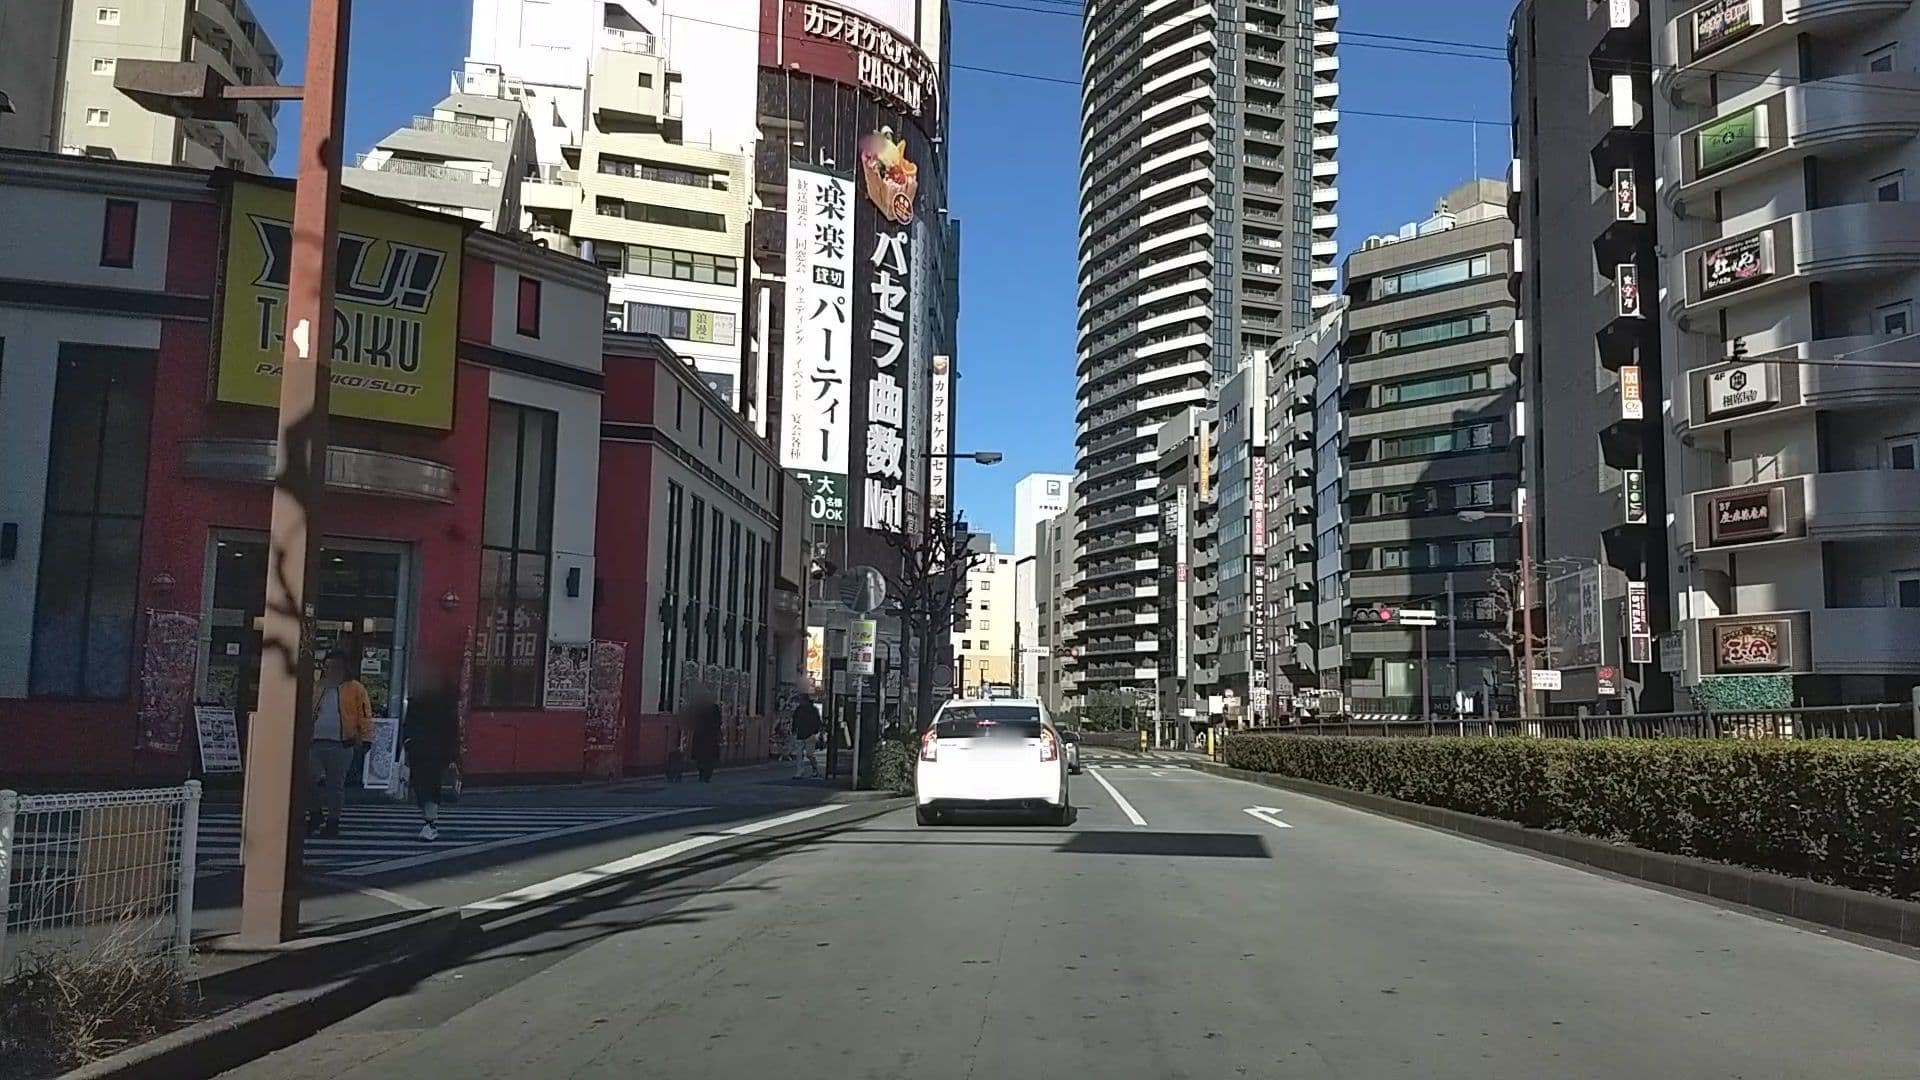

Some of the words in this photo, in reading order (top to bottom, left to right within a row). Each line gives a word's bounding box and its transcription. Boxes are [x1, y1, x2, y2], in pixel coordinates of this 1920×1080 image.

[814, 178, 846, 261] 楽楽
[808, 296, 846, 462] パーティー
[932, 378, 947, 488] カラオケパセラ
[1631, 595, 1642, 632] STEAK
